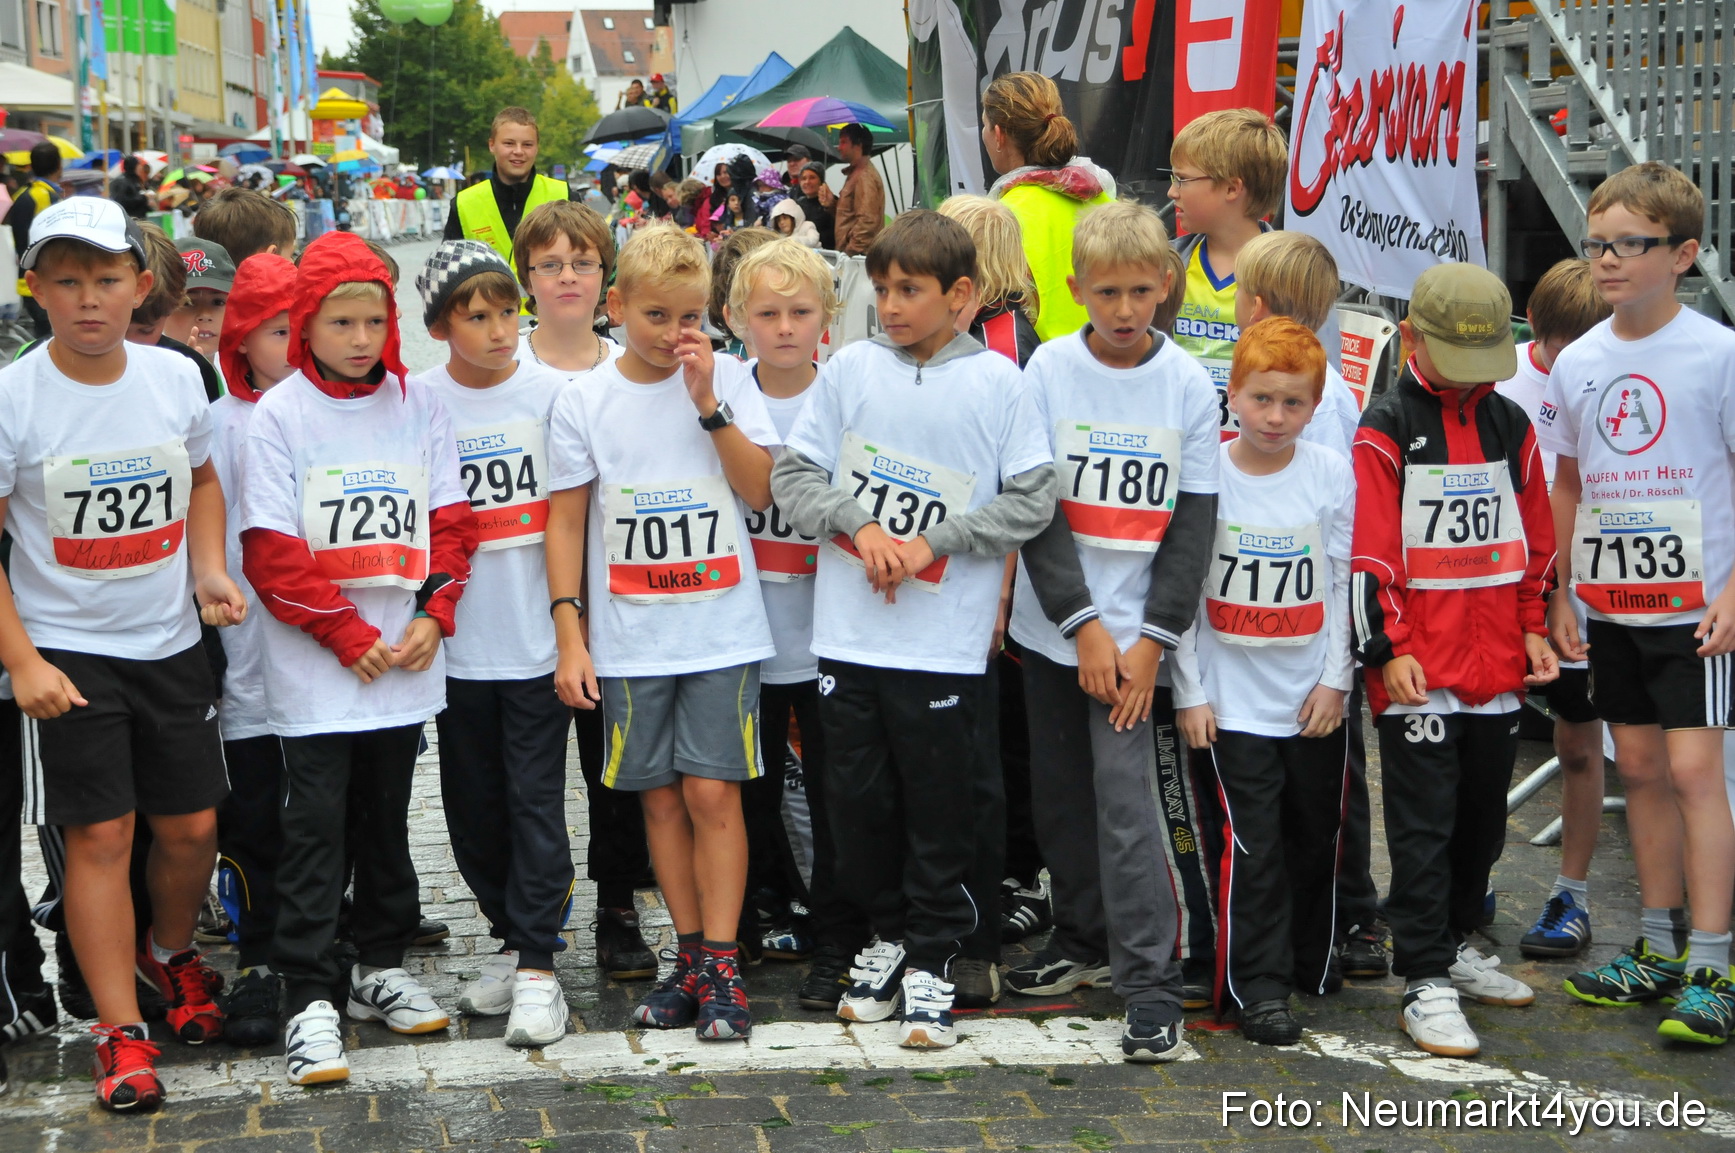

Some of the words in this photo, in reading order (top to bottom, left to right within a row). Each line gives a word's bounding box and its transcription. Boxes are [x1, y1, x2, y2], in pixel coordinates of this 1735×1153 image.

[1181, 303, 1220, 319] TEAM
[1175, 317, 1240, 342] BOCK
[1089, 431, 1148, 448] BOCK
[89, 456, 151, 477] BOCK
[873, 455, 931, 484] BOCK
[1584, 472, 1618, 484] AUFEN
[1624, 469, 1650, 481] MIT
[1657, 465, 1694, 480] HERZ
[343, 470, 396, 486] BOCK
[1067, 453, 1169, 507] 7180
[1442, 472, 1489, 487] BOCK
[634, 488, 693, 506] BOCK
[851, 470, 947, 536] 7130
[1629, 489, 1644, 498] Dr.
[1647, 486, 1683, 497] Röschl
[64, 476, 172, 534] 7321
[320, 494, 416, 544] 7234
[1419, 495, 1501, 544] 7367
[1600, 512, 1653, 525] BOCK
[616, 509, 719, 560] 7017
[1240, 533, 1294, 550] BOCK
[67, 537, 155, 569] Michael
[352, 549, 397, 571] André
[1436, 554, 1488, 569] Andreas
[1583, 534, 1686, 579] 7133
[647, 570, 703, 589] Lukas
[1219, 553, 1313, 603] 7170
[1606, 590, 1669, 608] Tilman
[1213, 604, 1306, 634] SIMON
[929, 699, 954, 709] JAKO
[1404, 713, 1446, 743] 30
[1172, 826, 1195, 854] 45
